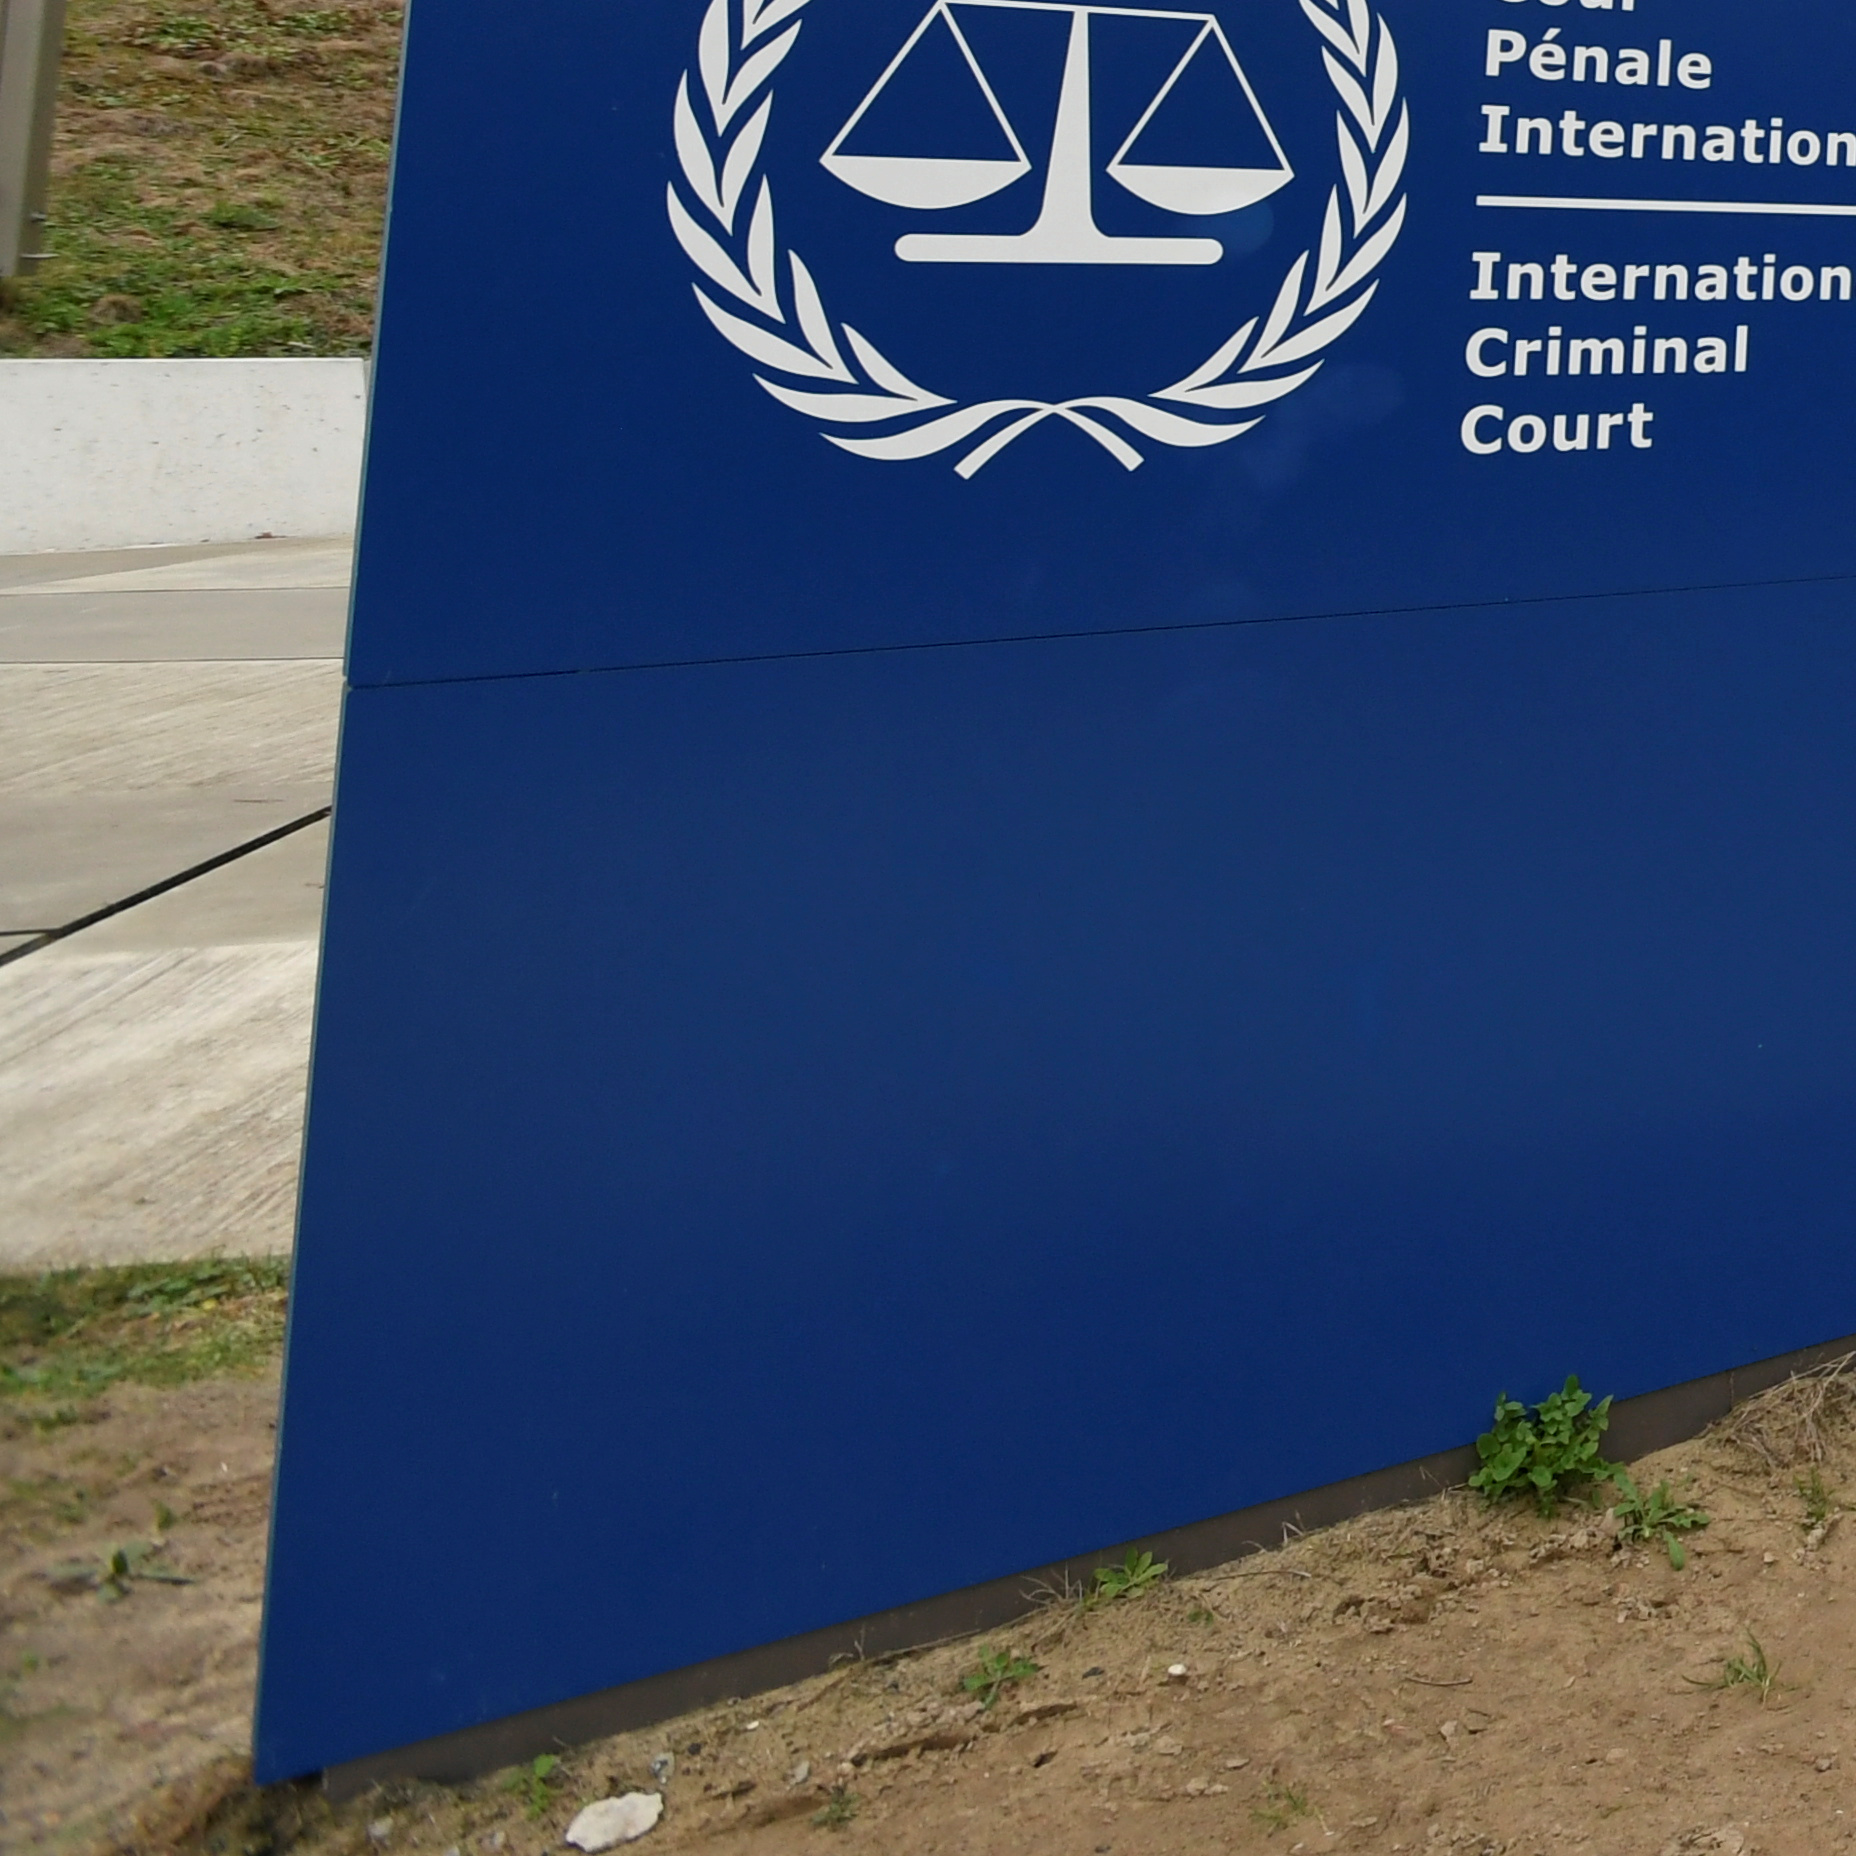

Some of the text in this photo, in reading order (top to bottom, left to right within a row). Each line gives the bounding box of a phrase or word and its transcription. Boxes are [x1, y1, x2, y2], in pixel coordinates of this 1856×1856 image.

[1485, 27, 1712, 90] Pénale
[1465, 324, 1749, 378] Criminal
[1460, 402, 1654, 455] Court
